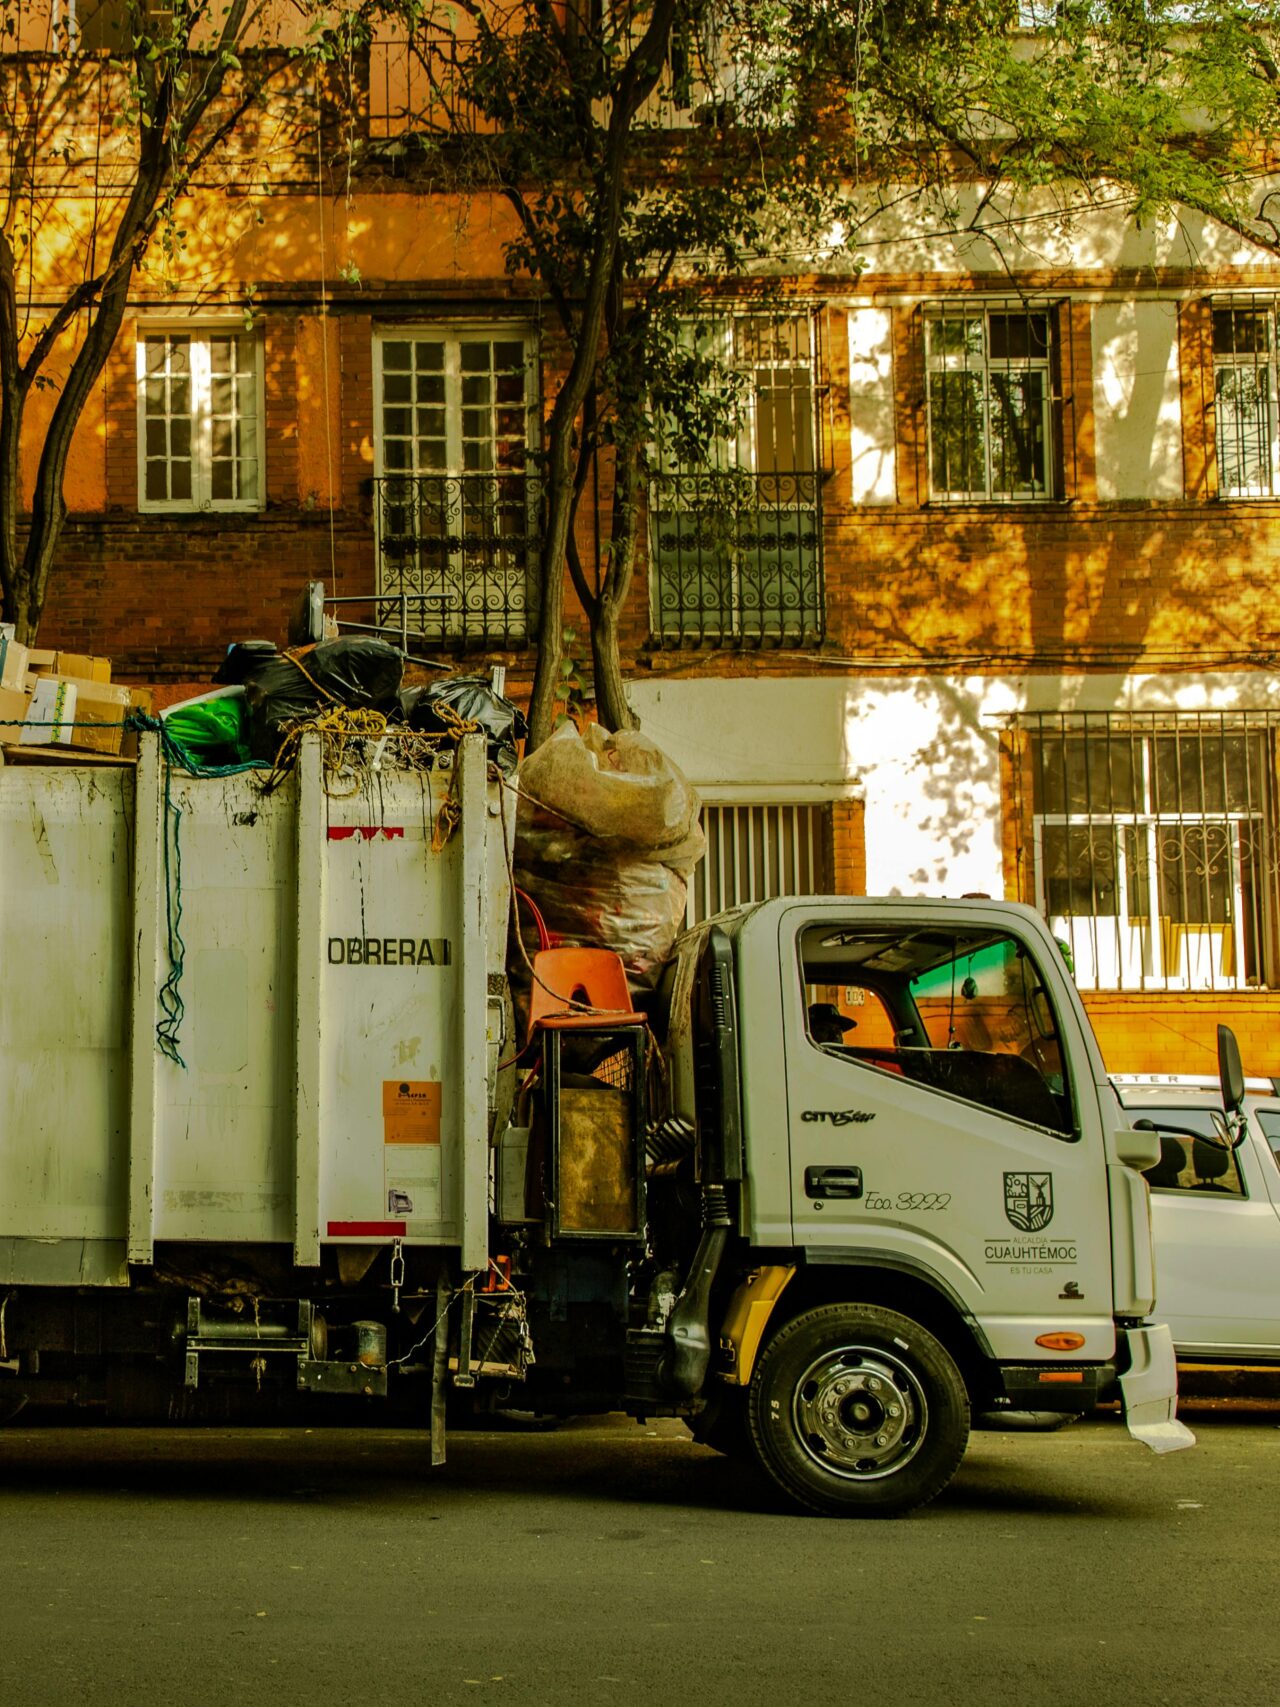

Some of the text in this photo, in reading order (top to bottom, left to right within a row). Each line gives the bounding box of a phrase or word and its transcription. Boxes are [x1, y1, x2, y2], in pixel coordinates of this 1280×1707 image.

[328, 937, 435, 966] OBRERA
[865, 1191, 951, 1210] Eco. 3222
[984, 1243, 1077, 1260] CUAUHTÉMOC
